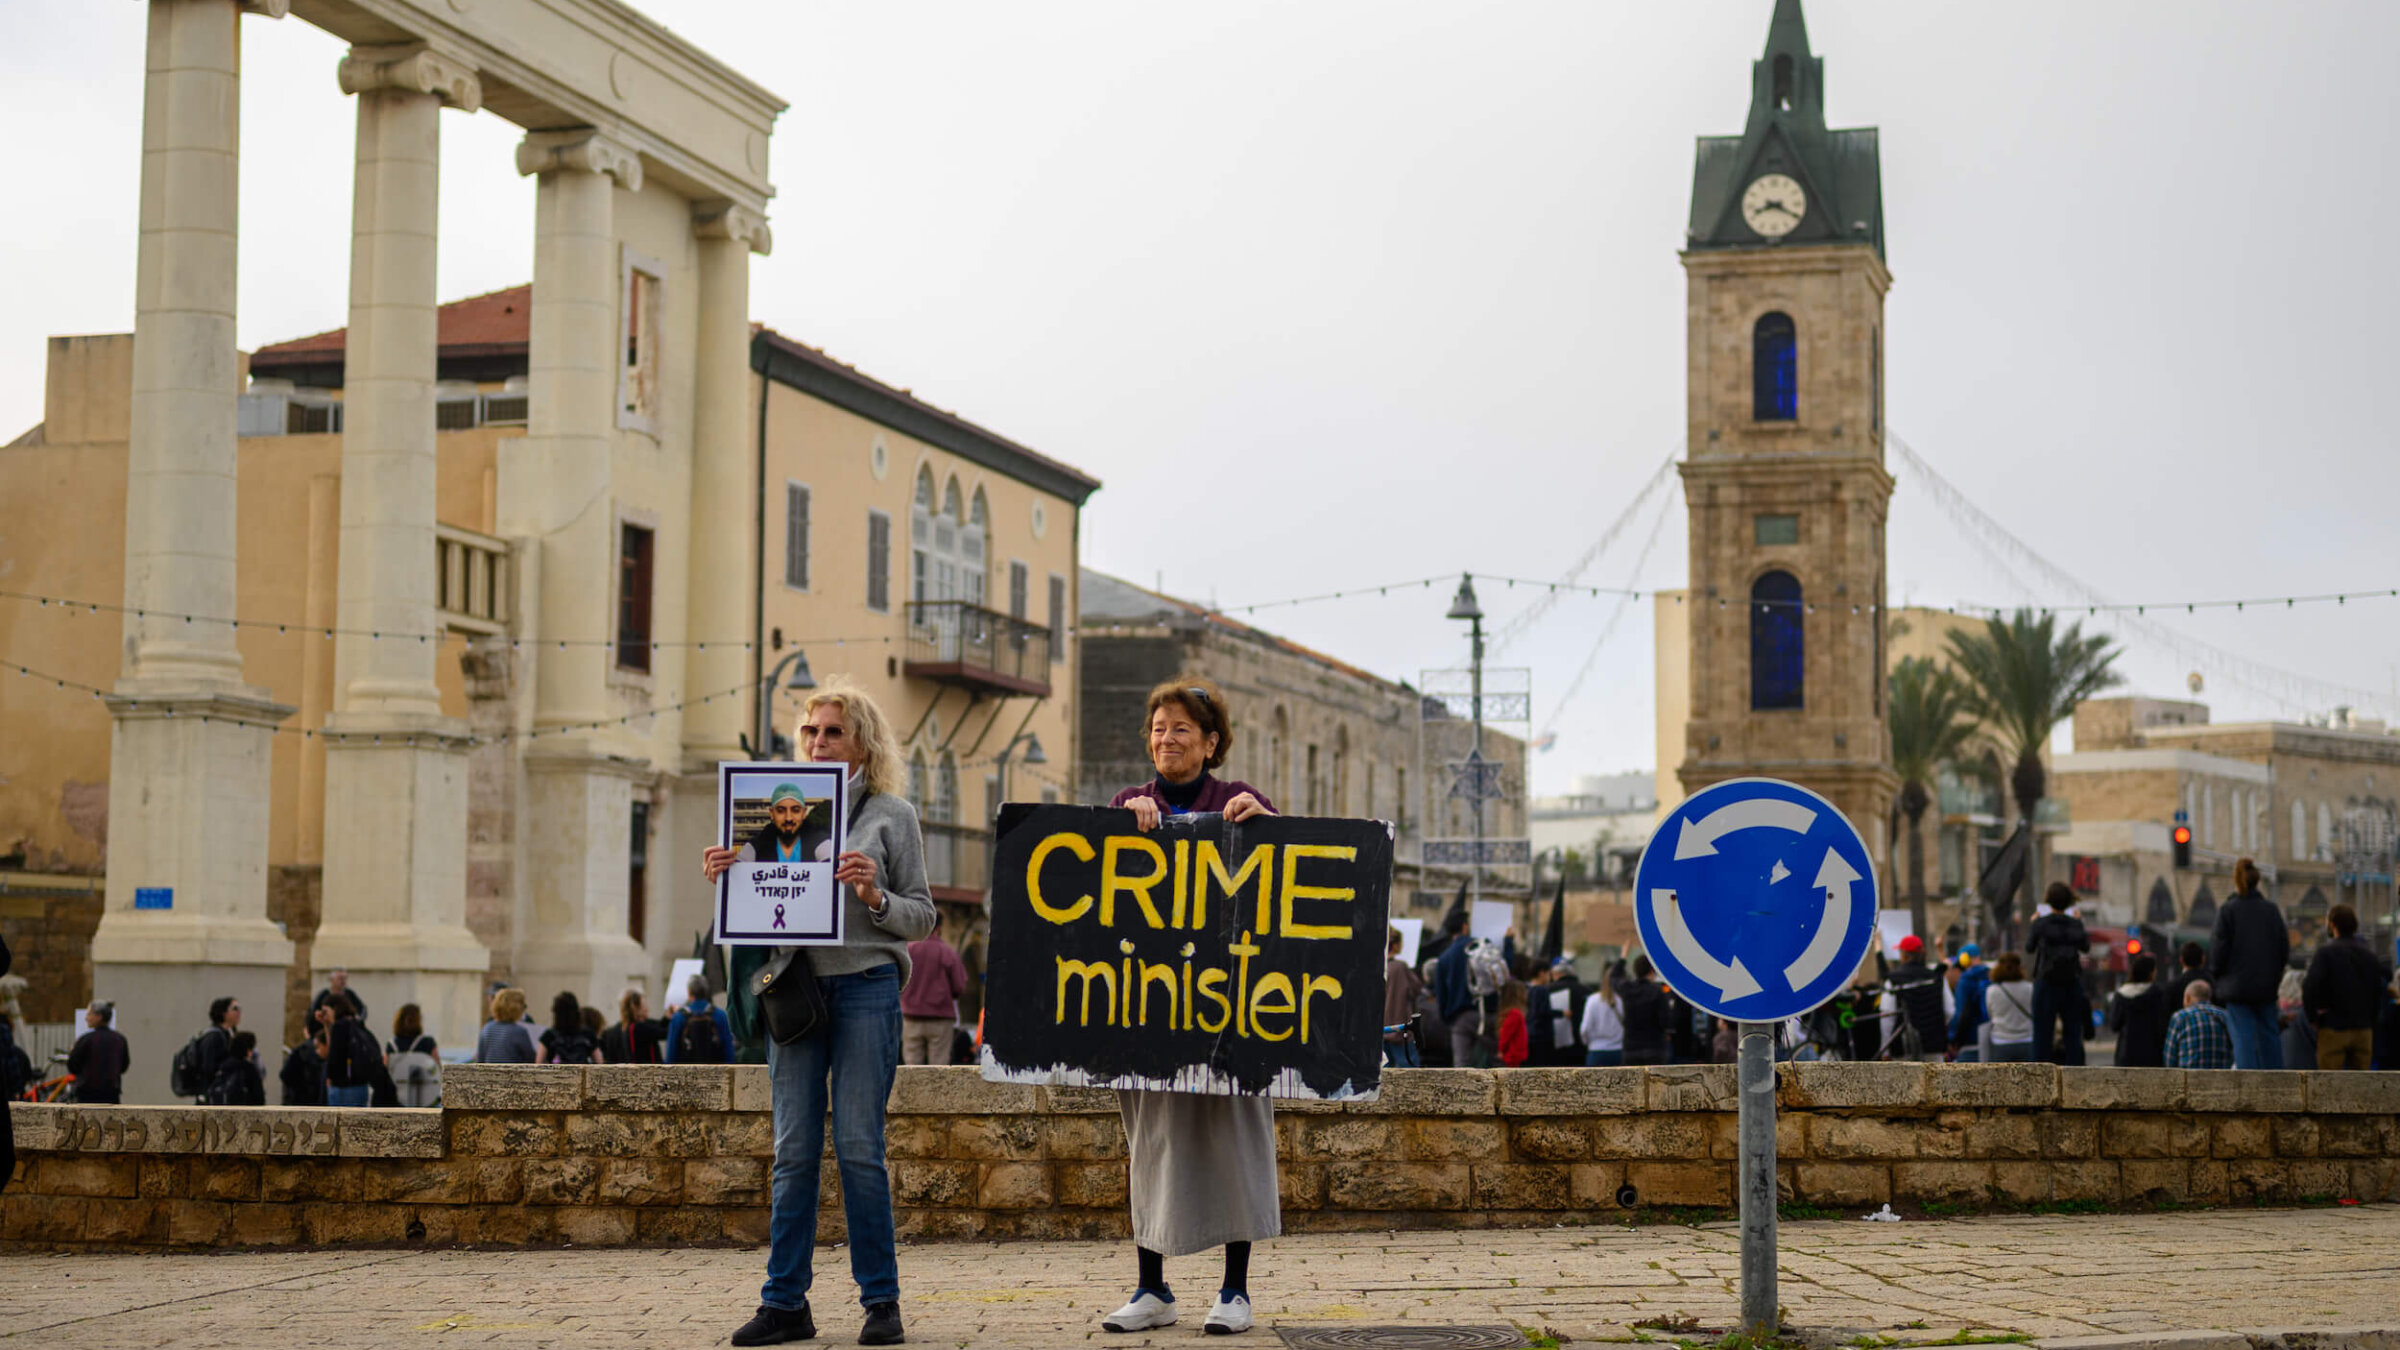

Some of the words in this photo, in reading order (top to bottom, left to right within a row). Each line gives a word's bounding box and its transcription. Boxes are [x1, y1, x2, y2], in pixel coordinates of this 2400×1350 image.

[752, 864, 788, 885] قادري
[755, 886, 789, 900] קאדרי
[791, 869, 810, 882] يزن
[791, 886, 806, 900] יזן
[1026, 832, 1358, 940] CRIME
[1055, 930, 1343, 1045] minister
[54, 1108, 149, 1150] כרמל
[160, 1115, 236, 1152] יוסי
[249, 1117, 336, 1154] כיכר
